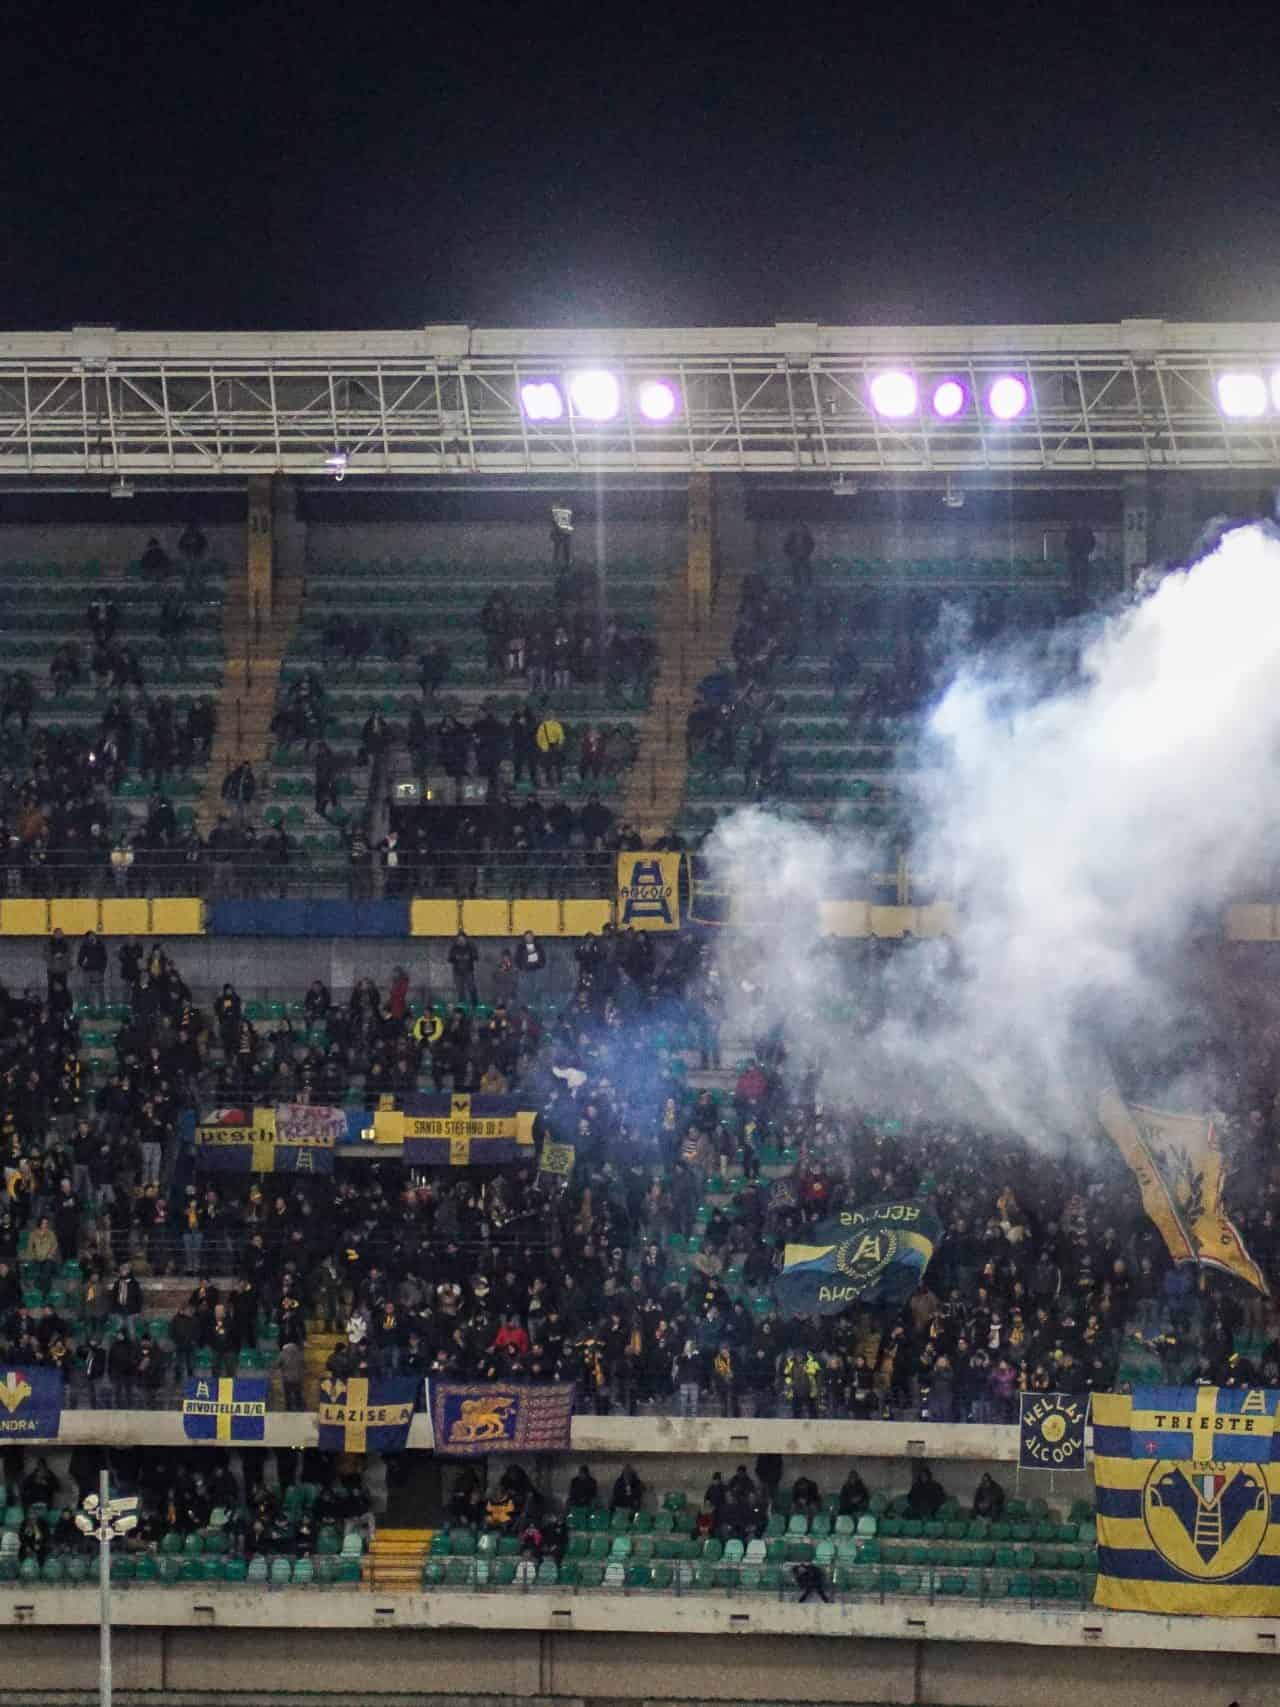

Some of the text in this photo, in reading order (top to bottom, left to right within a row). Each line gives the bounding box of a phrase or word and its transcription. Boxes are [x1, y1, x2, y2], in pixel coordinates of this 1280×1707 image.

[324, 1408, 387, 1422] LAZISE
[1154, 1414, 1255, 1432] TRIESTE
[1024, 1436, 1083, 1464] ALCOOL
